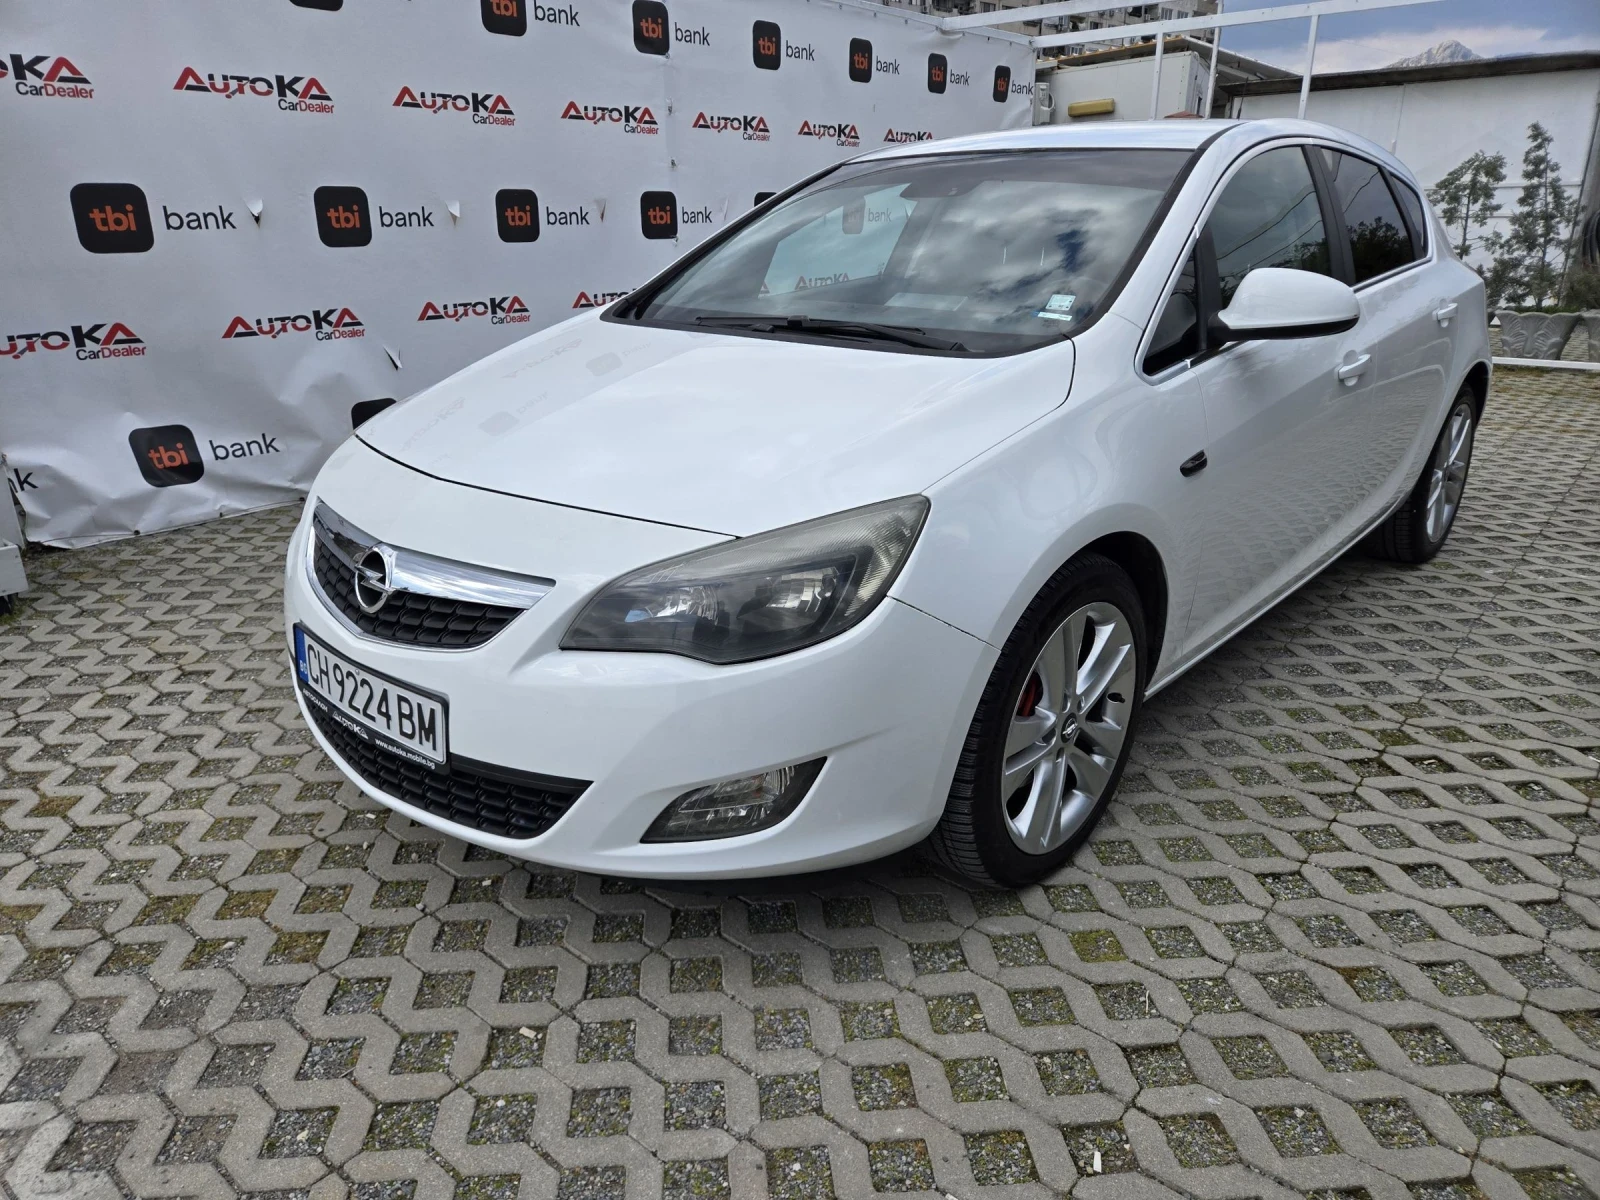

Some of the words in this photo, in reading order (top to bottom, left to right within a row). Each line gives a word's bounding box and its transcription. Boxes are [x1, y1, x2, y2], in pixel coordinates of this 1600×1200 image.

[533, 0, 580, 26] bank
[640, 17, 662, 39] tbi
[674, 23, 710, 46] bank
[758, 36, 776, 56] tbi
[785, 40, 815, 61] bank
[853, 53, 868, 69] tbi
[875, 56, 900, 75] bank
[931, 66, 944, 82] tbi
[949, 69, 970, 86] bank
[997, 76, 1007, 92] tbi
[1010, 79, 1034, 95] bank
[15, 81, 94, 99] CarDealer
[278, 98, 335, 114] CarDealer
[472, 113, 516, 127] CarDealer
[624, 123, 659, 135] CarDealer
[742, 131, 771, 142] CarDealer
[836, 138, 860, 148] CarDealer
[89, 204, 137, 232] tbi
[163, 205, 237, 231] bank
[327, 204, 361, 229] tbi
[379, 206, 435, 228] bank
[505, 205, 531, 227] tbi
[546, 207, 590, 226] bank
[648, 206, 671, 225] tbi
[682, 207, 713, 224] bank
[491, 314, 531, 325] CarDealer
[315, 327, 366, 341] CarDealer
[76, 345, 147, 361] CarDealer
[148, 443, 189, 470] tbi
[208, 433, 280, 461] bank
